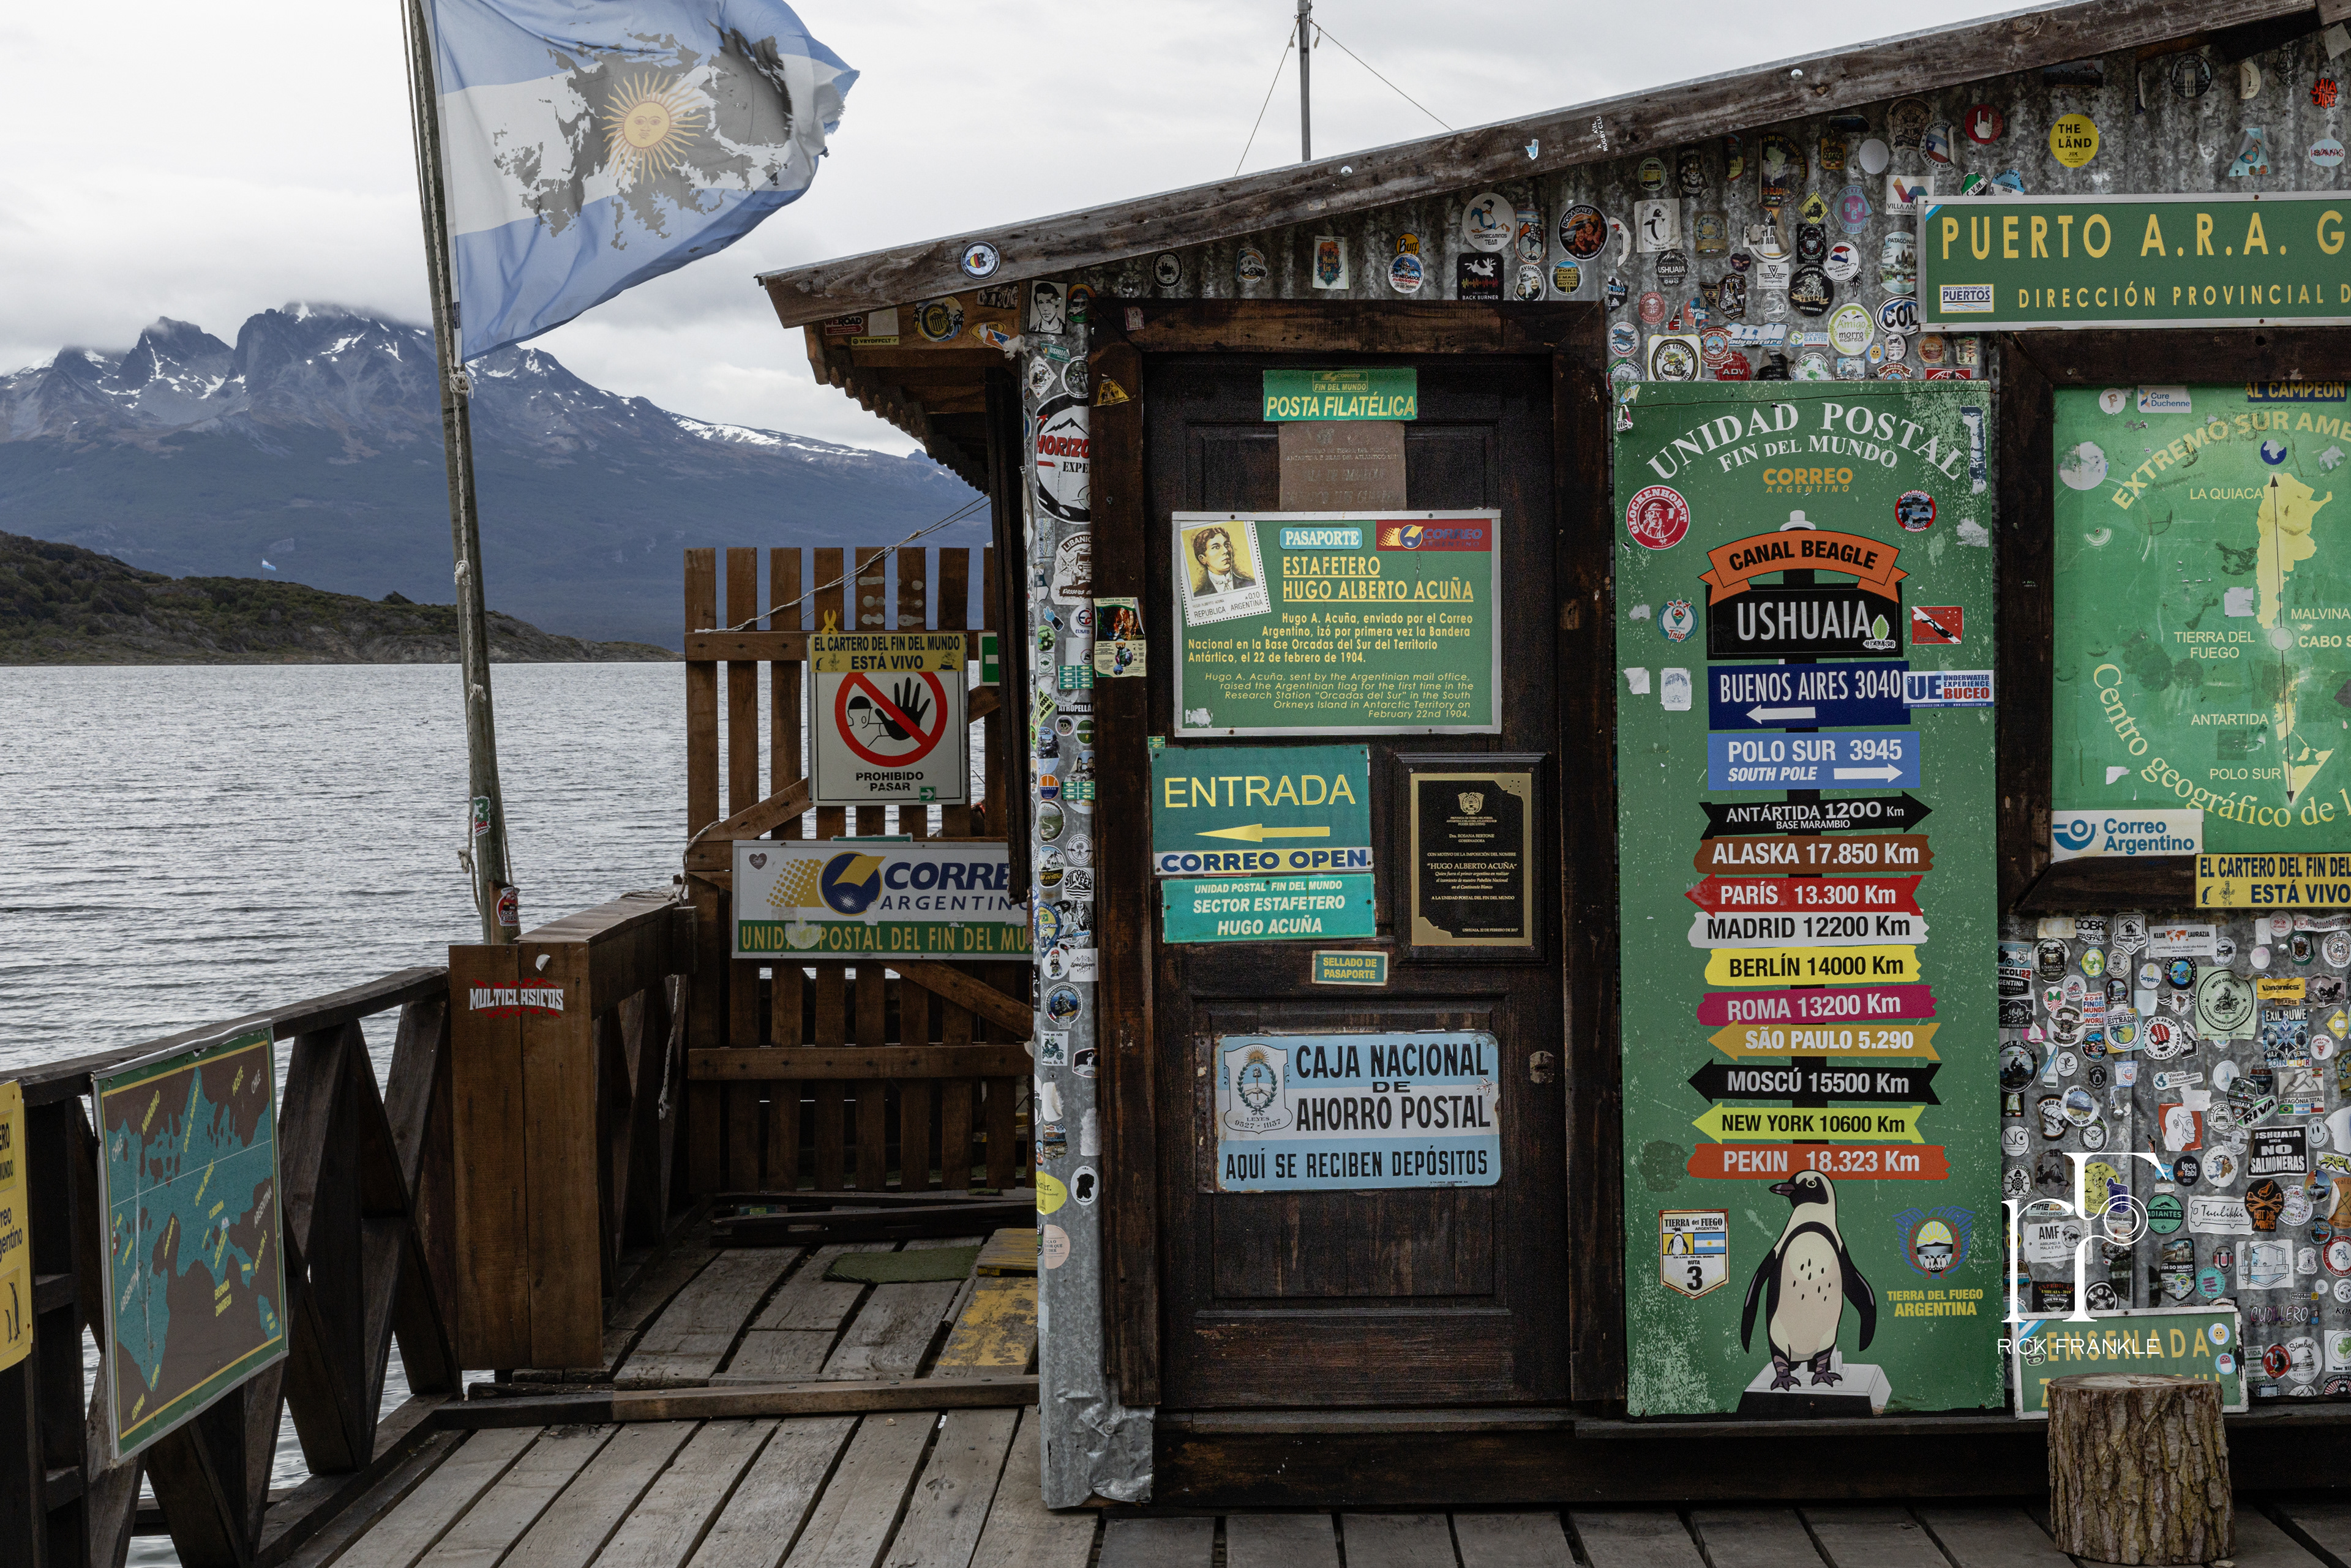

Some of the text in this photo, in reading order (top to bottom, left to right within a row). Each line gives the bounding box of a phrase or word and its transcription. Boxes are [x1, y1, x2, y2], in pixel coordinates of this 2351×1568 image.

[2058, 124, 2081, 133] THE
[2058, 135, 2092, 148] LÄND
[1943, 212, 2286, 260] PUERTO A.R.A.
[1943, 290, 1990, 300] PUERTOS
[2019, 281, 2323, 308] DIRECCIÓN PROVINCIAL
[1267, 392, 1414, 416] POSTA FILATÉLICA
[2151, 399, 2190, 408] Duchenne
[1646, 402, 1963, 480] UNIDAD POSTAL
[1717, 435, 1898, 473] FIN DEL MUNDO
[2112, 411, 2289, 510] EXTREMO SUR
[1763, 468, 1853, 485] CORREO
[1766, 485, 1849, 493] ARGENTINO
[2190, 488, 2264, 500] LA QUIACA
[1286, 530, 1359, 546] PASAPORTE
[1423, 529, 1482, 539] CORREO
[1729, 540, 1878, 572] CANAL BEAGLE
[1284, 557, 1380, 575] ESTAFETERO
[1284, 580, 1473, 599] HUGO ALBERTO ACUÑA
[1194, 599, 1263, 618] REPUBLICA ARGENTINA
[1738, 601, 1872, 640] USHUAIA
[815, 636, 959, 651] EL CARTERO DEL FIN DEL MUNDO
[2174, 631, 2255, 643] TIERRA DEL
[852, 653, 923, 669] ESTÁ VIVO
[1189, 651, 1365, 663] Antártico, el 22 de febrero de 1904.
[2191, 647, 2239, 658] FUEGO
[1720, 670, 1900, 702] BUENOS AIRES 3040
[1369, 710, 1412, 719] February
[2191, 713, 2269, 726] ANTARTIDA
[1729, 739, 1902, 762] POLO SUR 3945
[2093, 663, 2335, 827] Centro geográfico de
[856, 771, 923, 781] PROHIBIDO
[1728, 767, 1818, 781] SOUTH POLE
[2210, 768, 2281, 779] POLO SUR
[870, 782, 910, 791] PASAR
[1164, 775, 1355, 808] ENTRADA
[1727, 801, 1904, 822] ANTÁRTIDA 1200 Km
[1801, 820, 1850, 828] MARAMBIO
[2104, 819, 2166, 834] Correo
[1712, 843, 1918, 864] ALASKA 17.850 Km
[2104, 835, 2194, 855] Argentino
[1161, 849, 1367, 872] CORREO OPEN
[2200, 857, 2214, 877] EL
[2219, 857, 2275, 877] CARTERO
[2280, 857, 2302, 877] DEL
[2306, 857, 2325, 877] FIN
[884, 862, 1010, 890] CORRE
[1194, 880, 1342, 893] UNIDAD POSTAL FIN DEL MUNDO
[2251, 879, 2350, 903] ESTÁ VIVO
[1193, 895, 1345, 913] SECTOR ESTAFETERO
[1218, 915, 1322, 936] HUGO ACUÑA
[820, 927, 994, 951] POSTAL DEL FIN DEL
[1323, 958, 1376, 967] SELLADO DE
[1324, 969, 1376, 979] PASAPORTE
[470, 988, 564, 1011] MULTICLASICOS
[1745, 1026, 1914, 1049] SÃO PAULO 5.290
[1296, 1043, 1489, 1078] CAJA NACIONAL
[232, 1066, 244, 1096] HOSTE
[1373, 1081, 1410, 1093] DE
[1297, 1095, 1490, 1131] AHORRO POSTAL
[1234, 1119, 1281, 1128] 9527 11137
[1722, 1115, 1904, 1132] NEW YORK 10600 Km
[2261, 1144, 2292, 1155] NO
[1226, 1146, 1487, 1181] AQUÍ SE RECIBEN DEPÓSITOS
[1724, 1150, 1919, 1172] PEKIN 18.323 Km
[2251, 1155, 2304, 1173] SALMONERAS
[2039, 1226, 2060, 1240] AMF
[1887, 1289, 1983, 1301] TIERRA DEL FUEGO
[1894, 1302, 1977, 1316] ARGENTINA
[2047, 1328, 2210, 1362] ENSENADA
